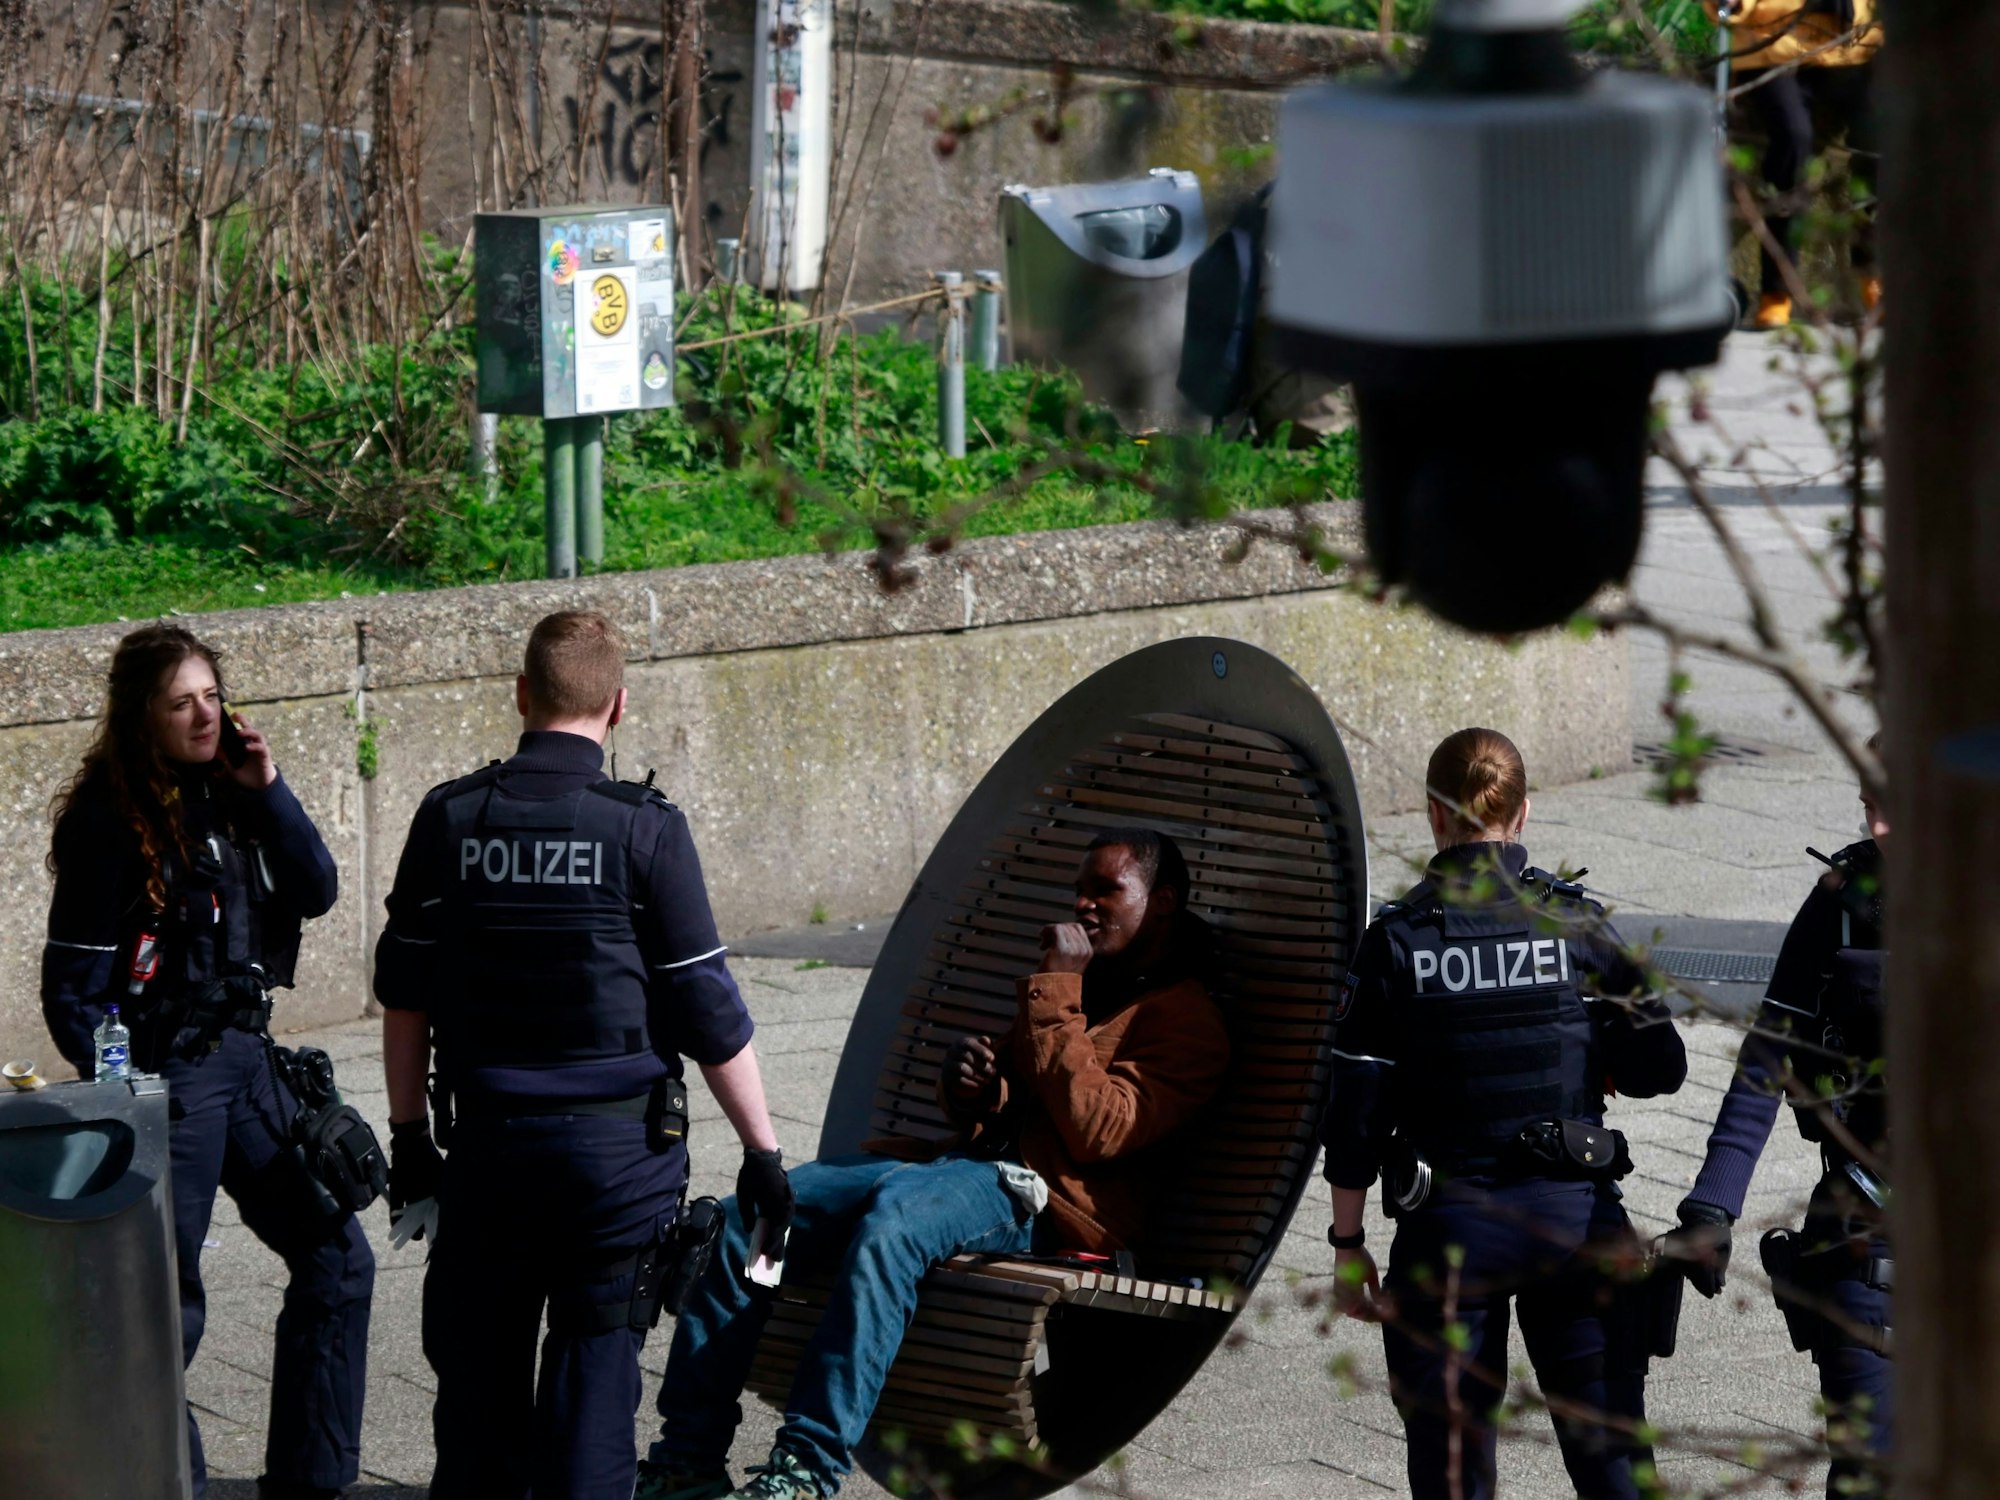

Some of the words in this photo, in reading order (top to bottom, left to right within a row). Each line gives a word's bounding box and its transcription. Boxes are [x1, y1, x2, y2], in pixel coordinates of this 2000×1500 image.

[598, 283, 622, 329] BVB
[460, 838, 603, 885] POLIZEI
[1413, 938, 1569, 993] POLIZEI
